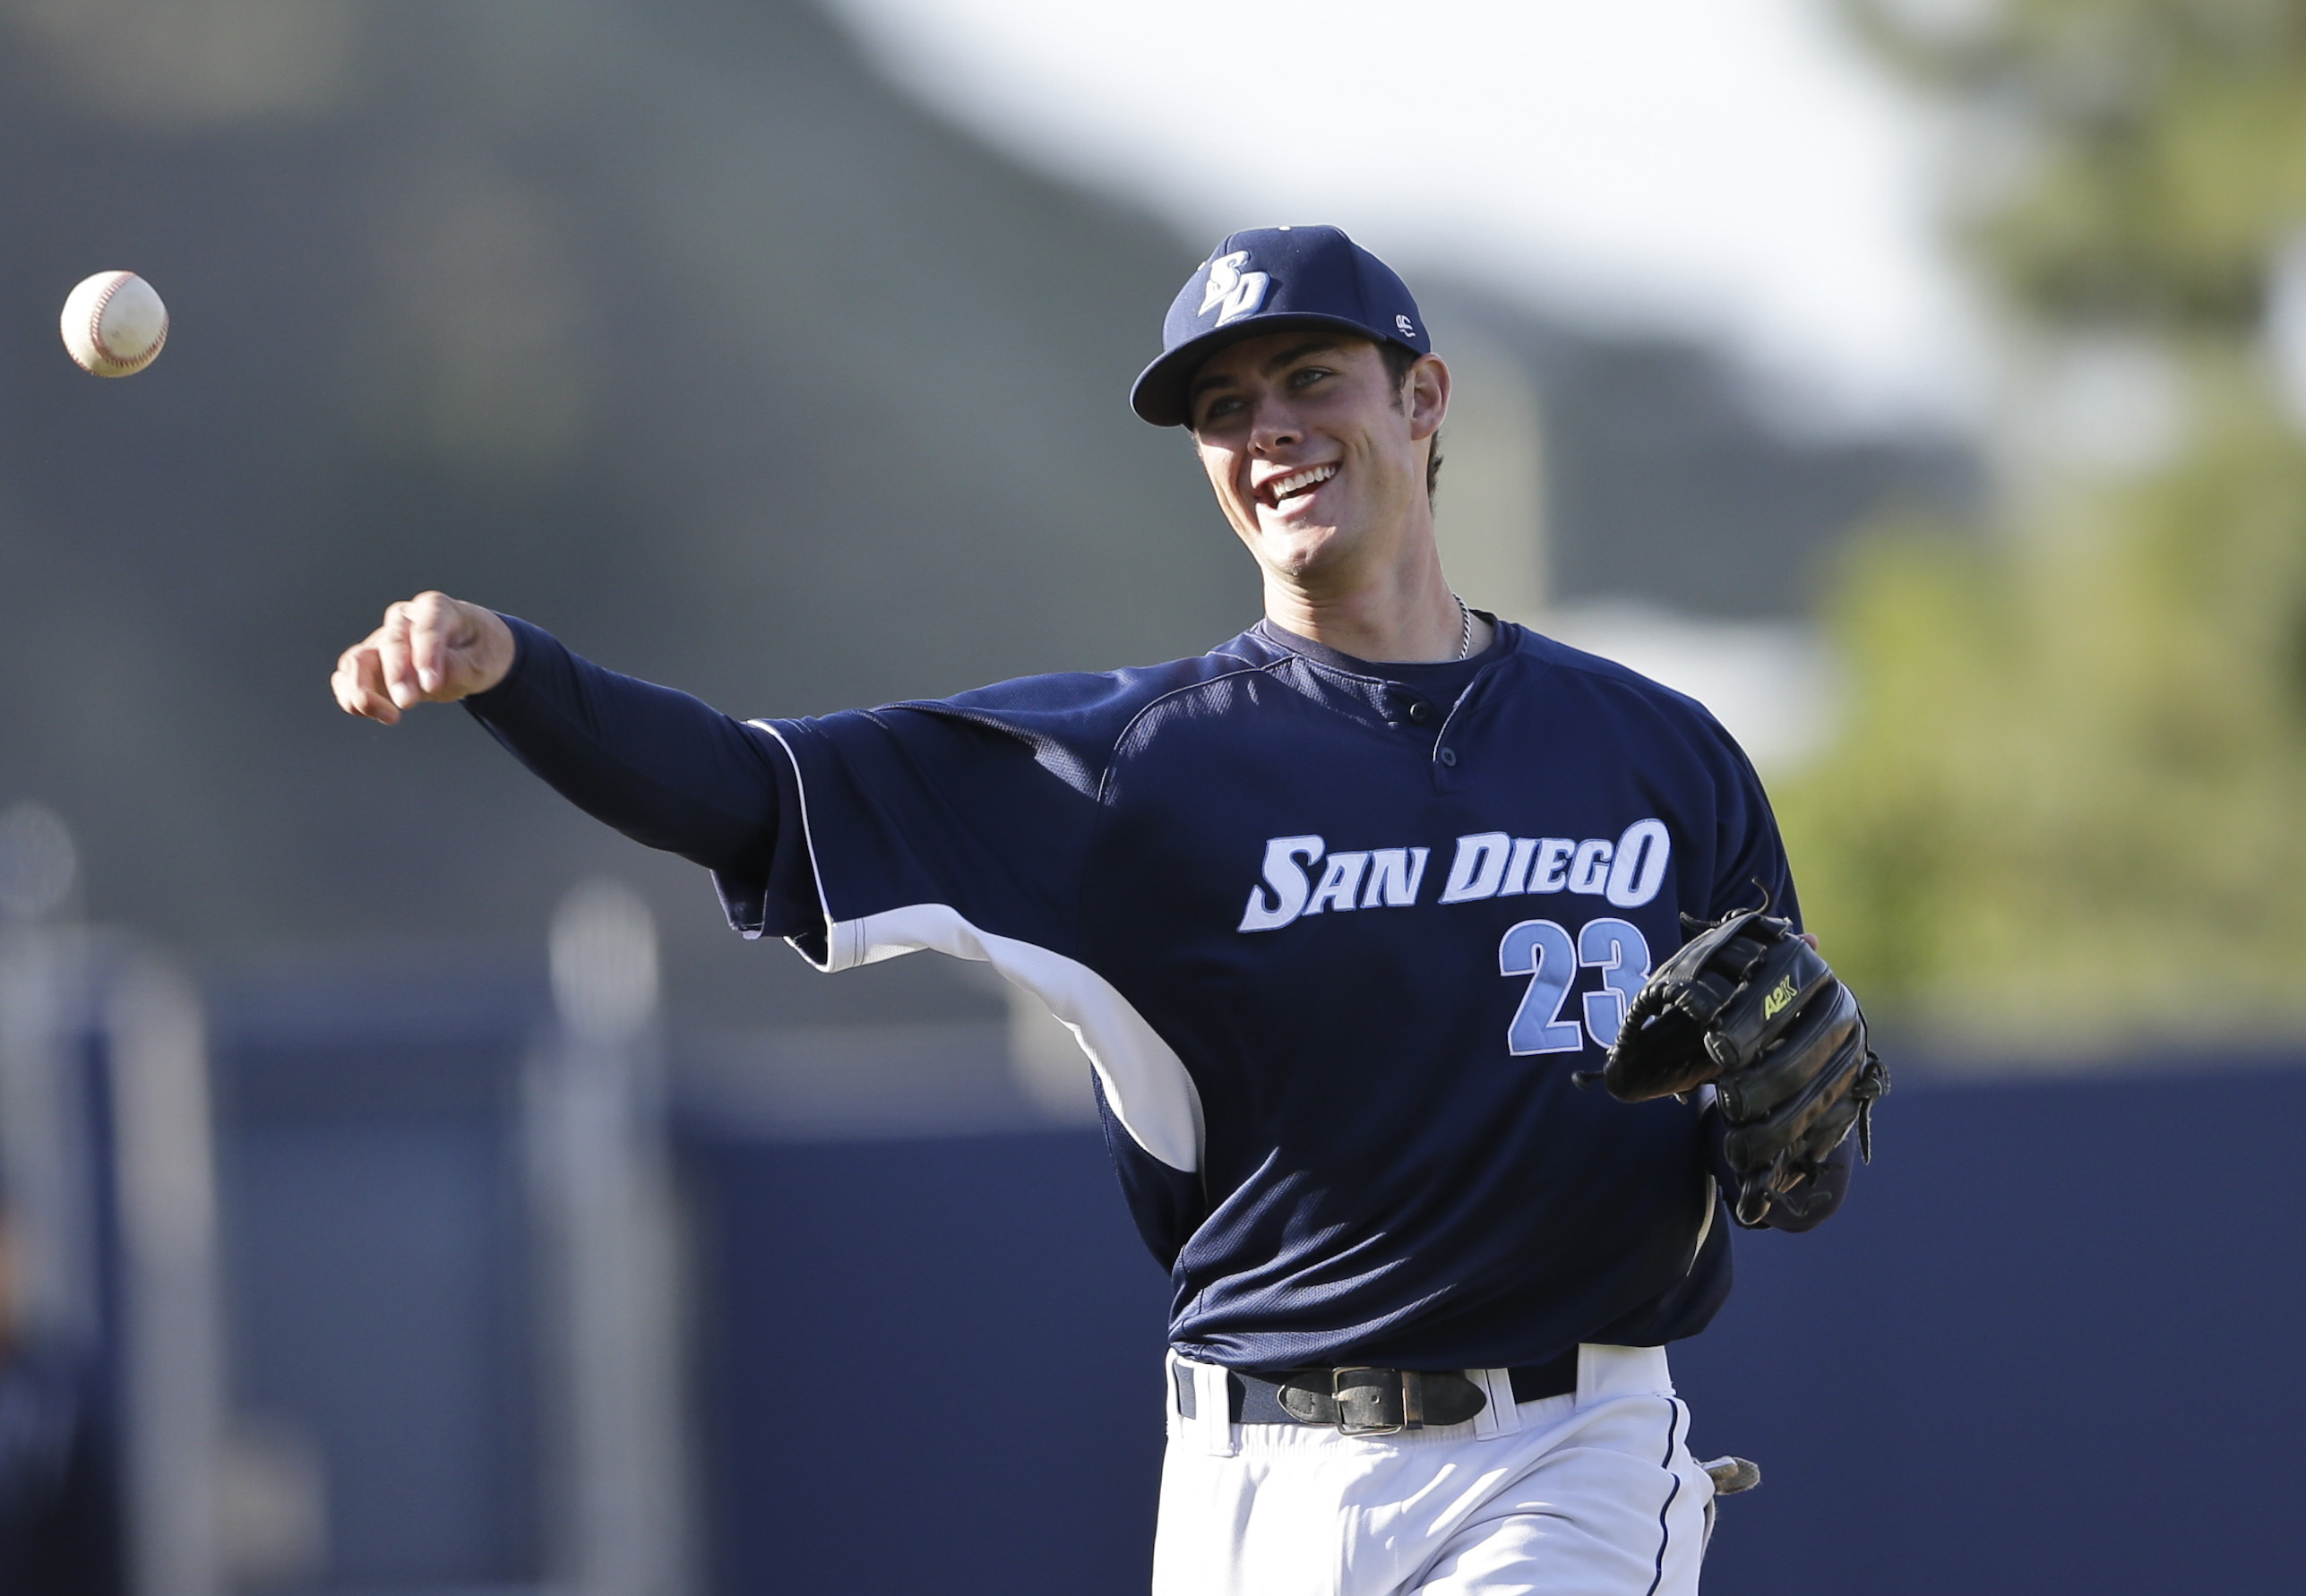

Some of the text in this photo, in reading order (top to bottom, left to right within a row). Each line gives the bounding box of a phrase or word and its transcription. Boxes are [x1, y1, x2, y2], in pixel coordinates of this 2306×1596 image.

[1198, 250, 1270, 328] SD
[1237, 818, 1672, 932] SAN DIEGO
[1499, 917, 1652, 1056] 23
[1764, 974, 1797, 1020] A2K
